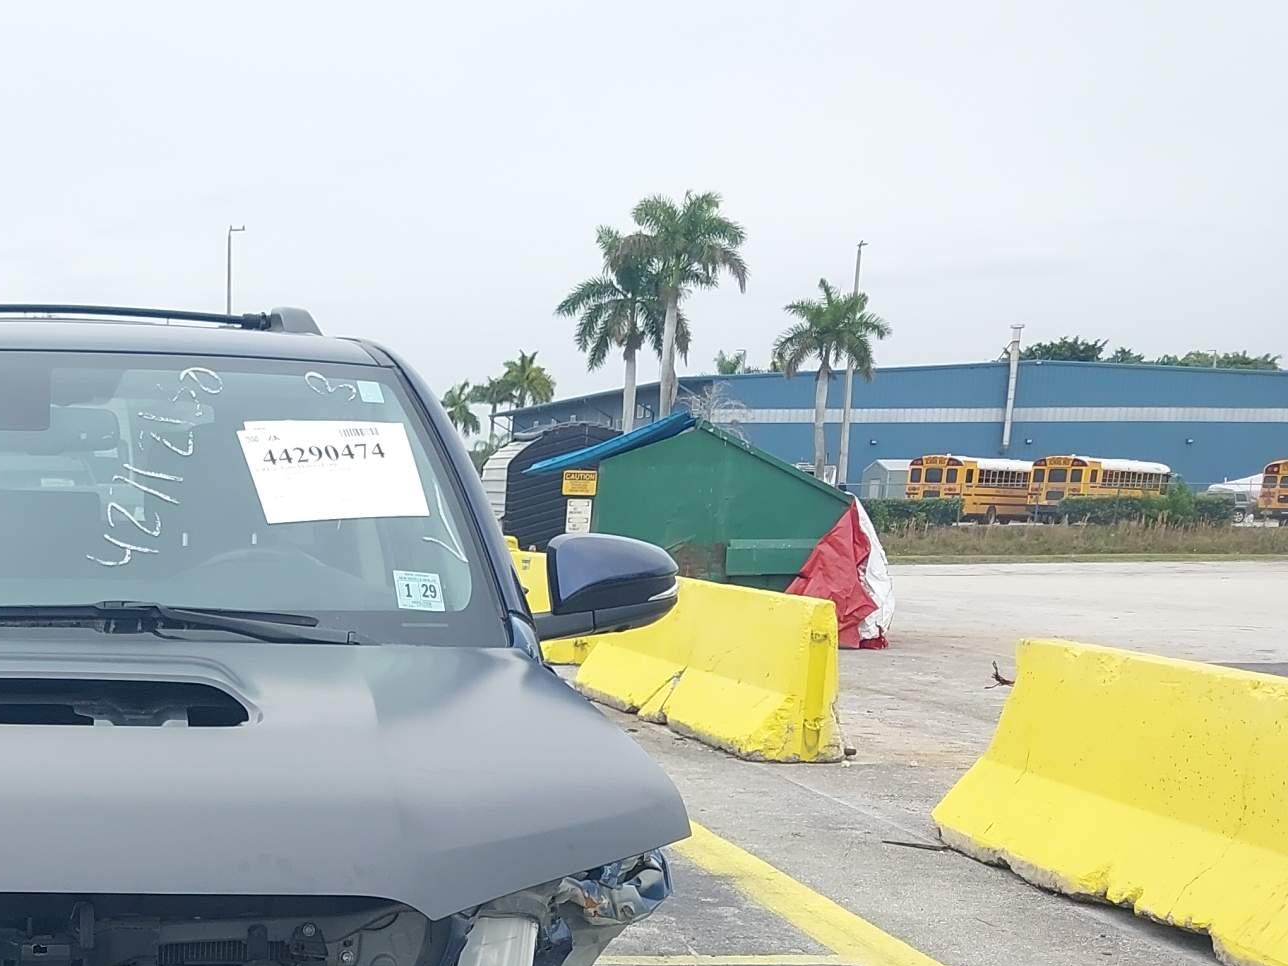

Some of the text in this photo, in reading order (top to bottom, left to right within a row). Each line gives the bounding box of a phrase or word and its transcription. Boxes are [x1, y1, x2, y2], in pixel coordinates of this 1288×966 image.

[263, 442, 385, 466] 44290474
[565, 472, 596, 480] CAUTION
[405, 583, 438, 599] 1 29
